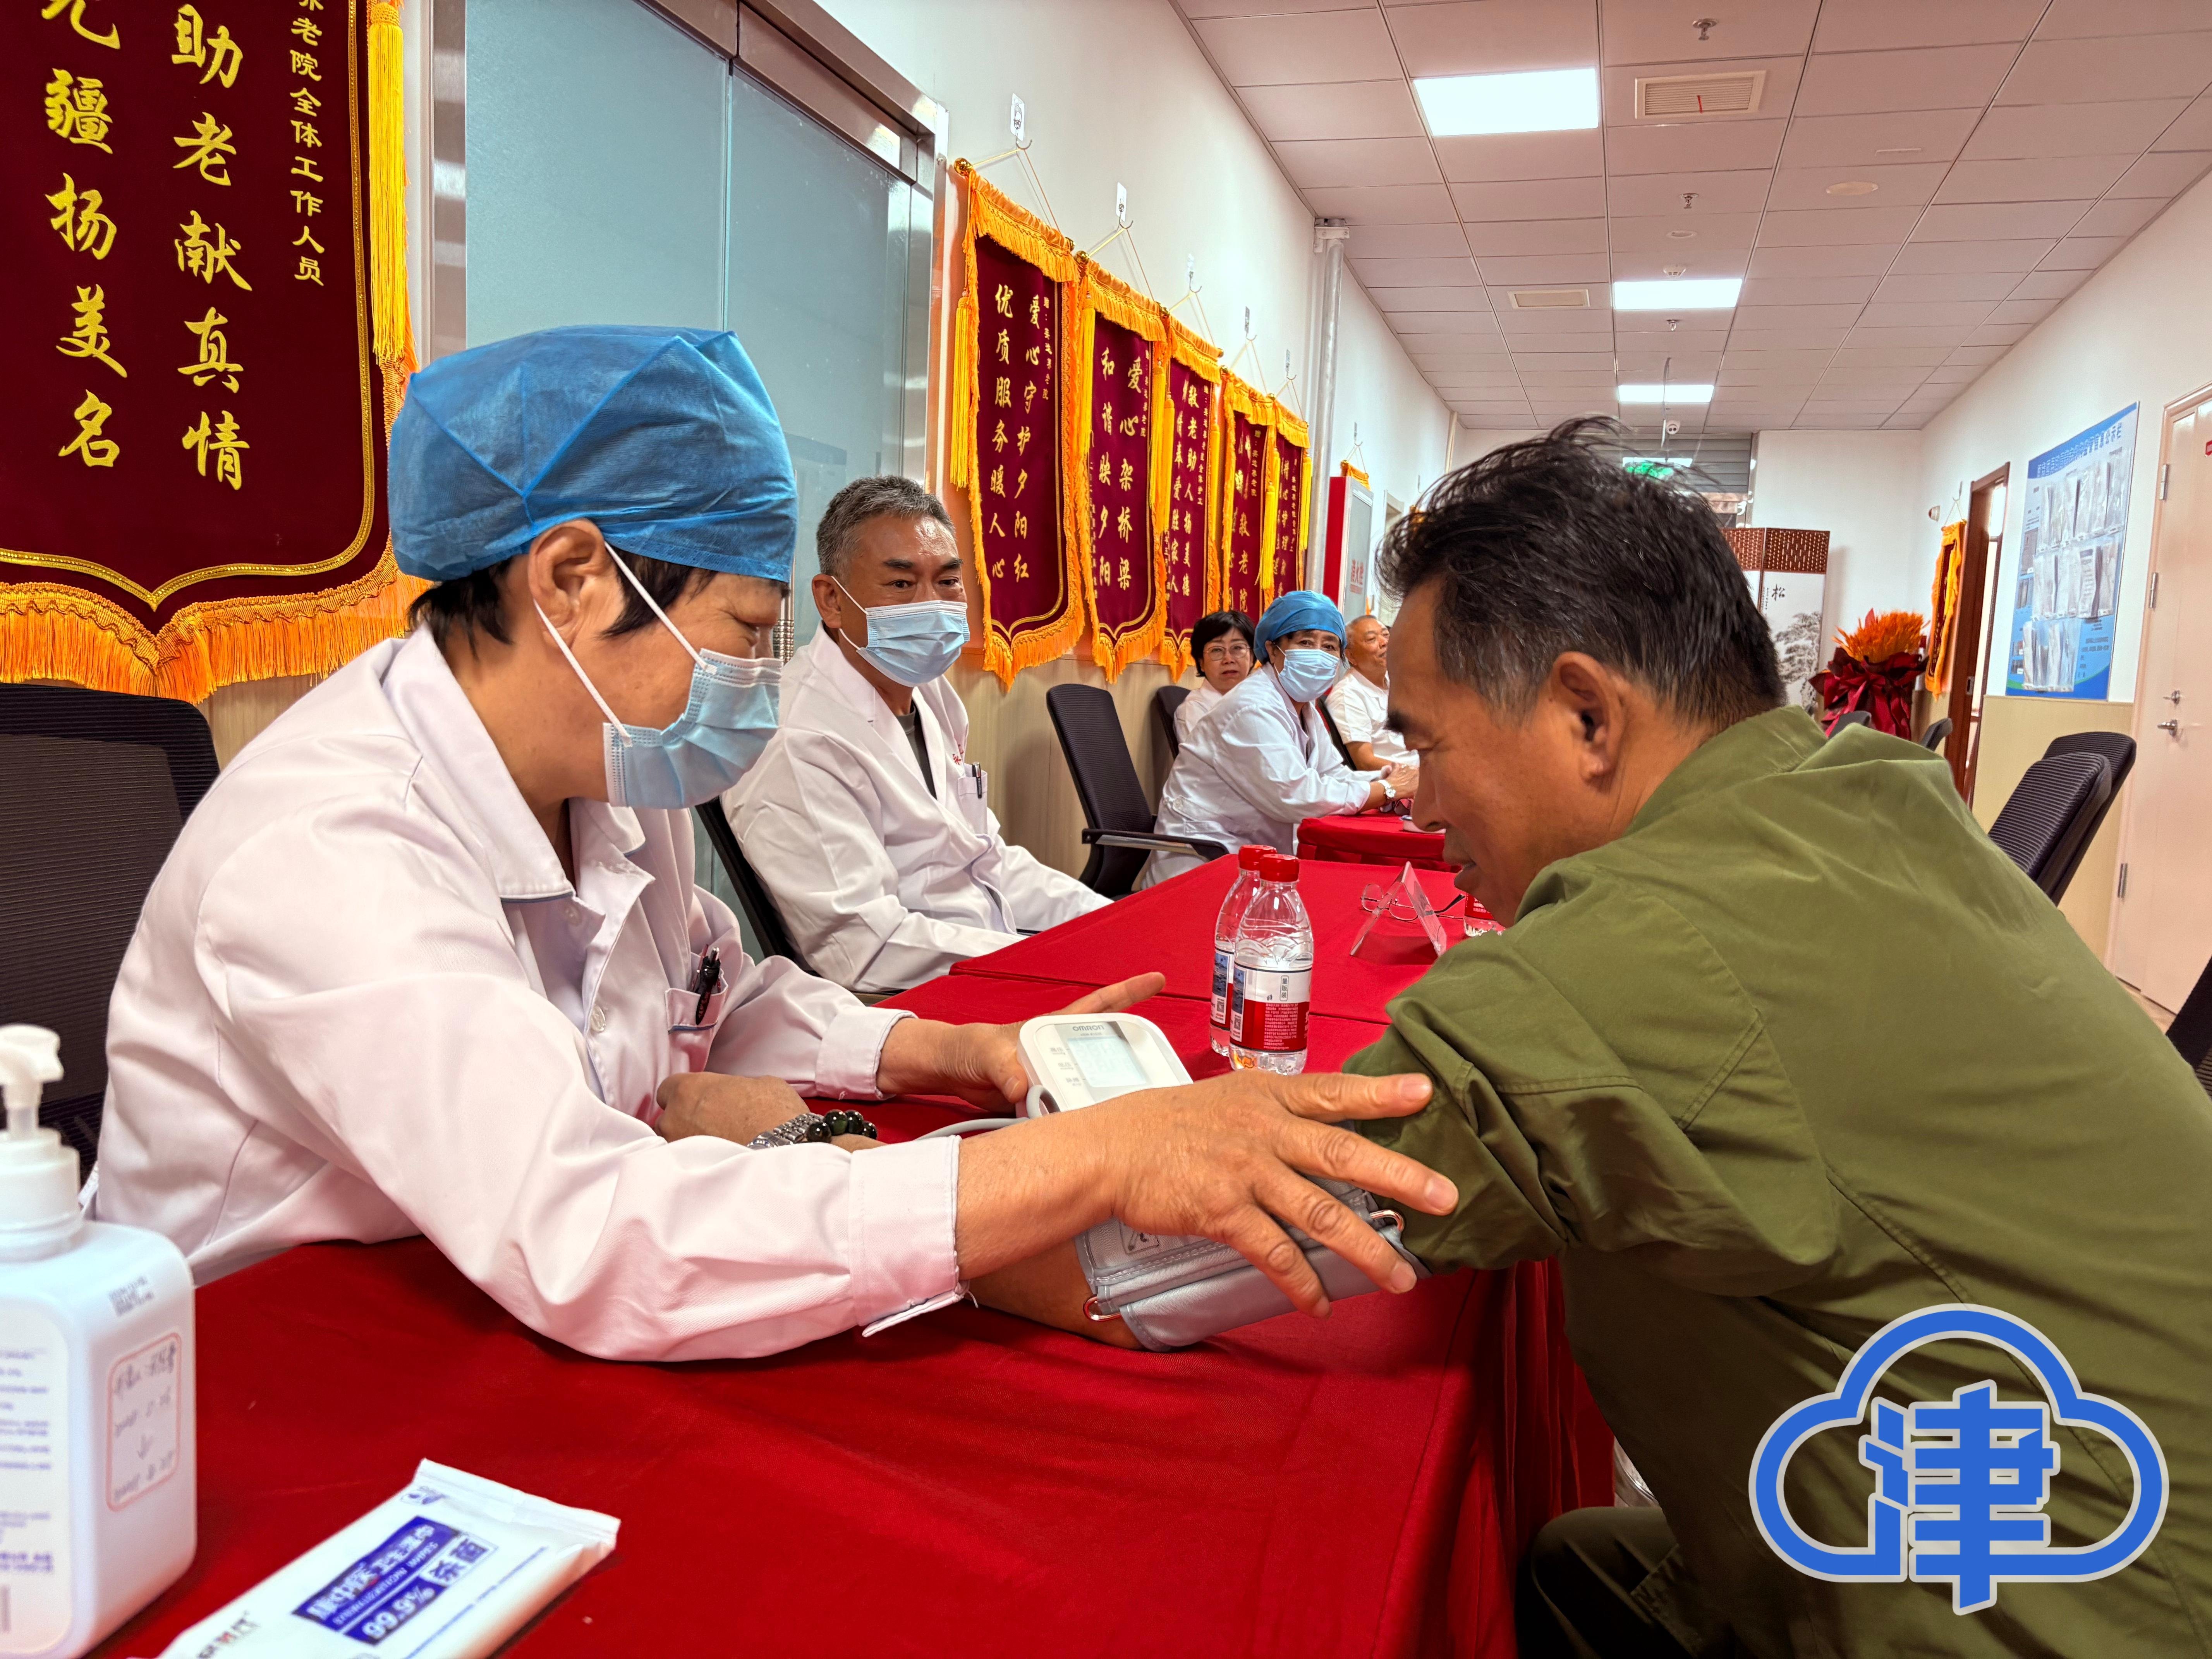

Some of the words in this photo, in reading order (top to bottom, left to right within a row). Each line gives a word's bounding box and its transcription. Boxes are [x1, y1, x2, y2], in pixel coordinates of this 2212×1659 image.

[171, 4, 252, 490] 助老献真情
[989, 283, 1013, 579] 优质服务暖人心
[1014, 294, 1040, 582] 爱心守护夕阳红
[1099, 347, 1115, 586] 和谐映夕阳
[1118, 356, 1142, 591] 爱心架桥梁
[1771, 584, 1785, 601] 松
[362, 1585, 436, 1640] 99.9%
